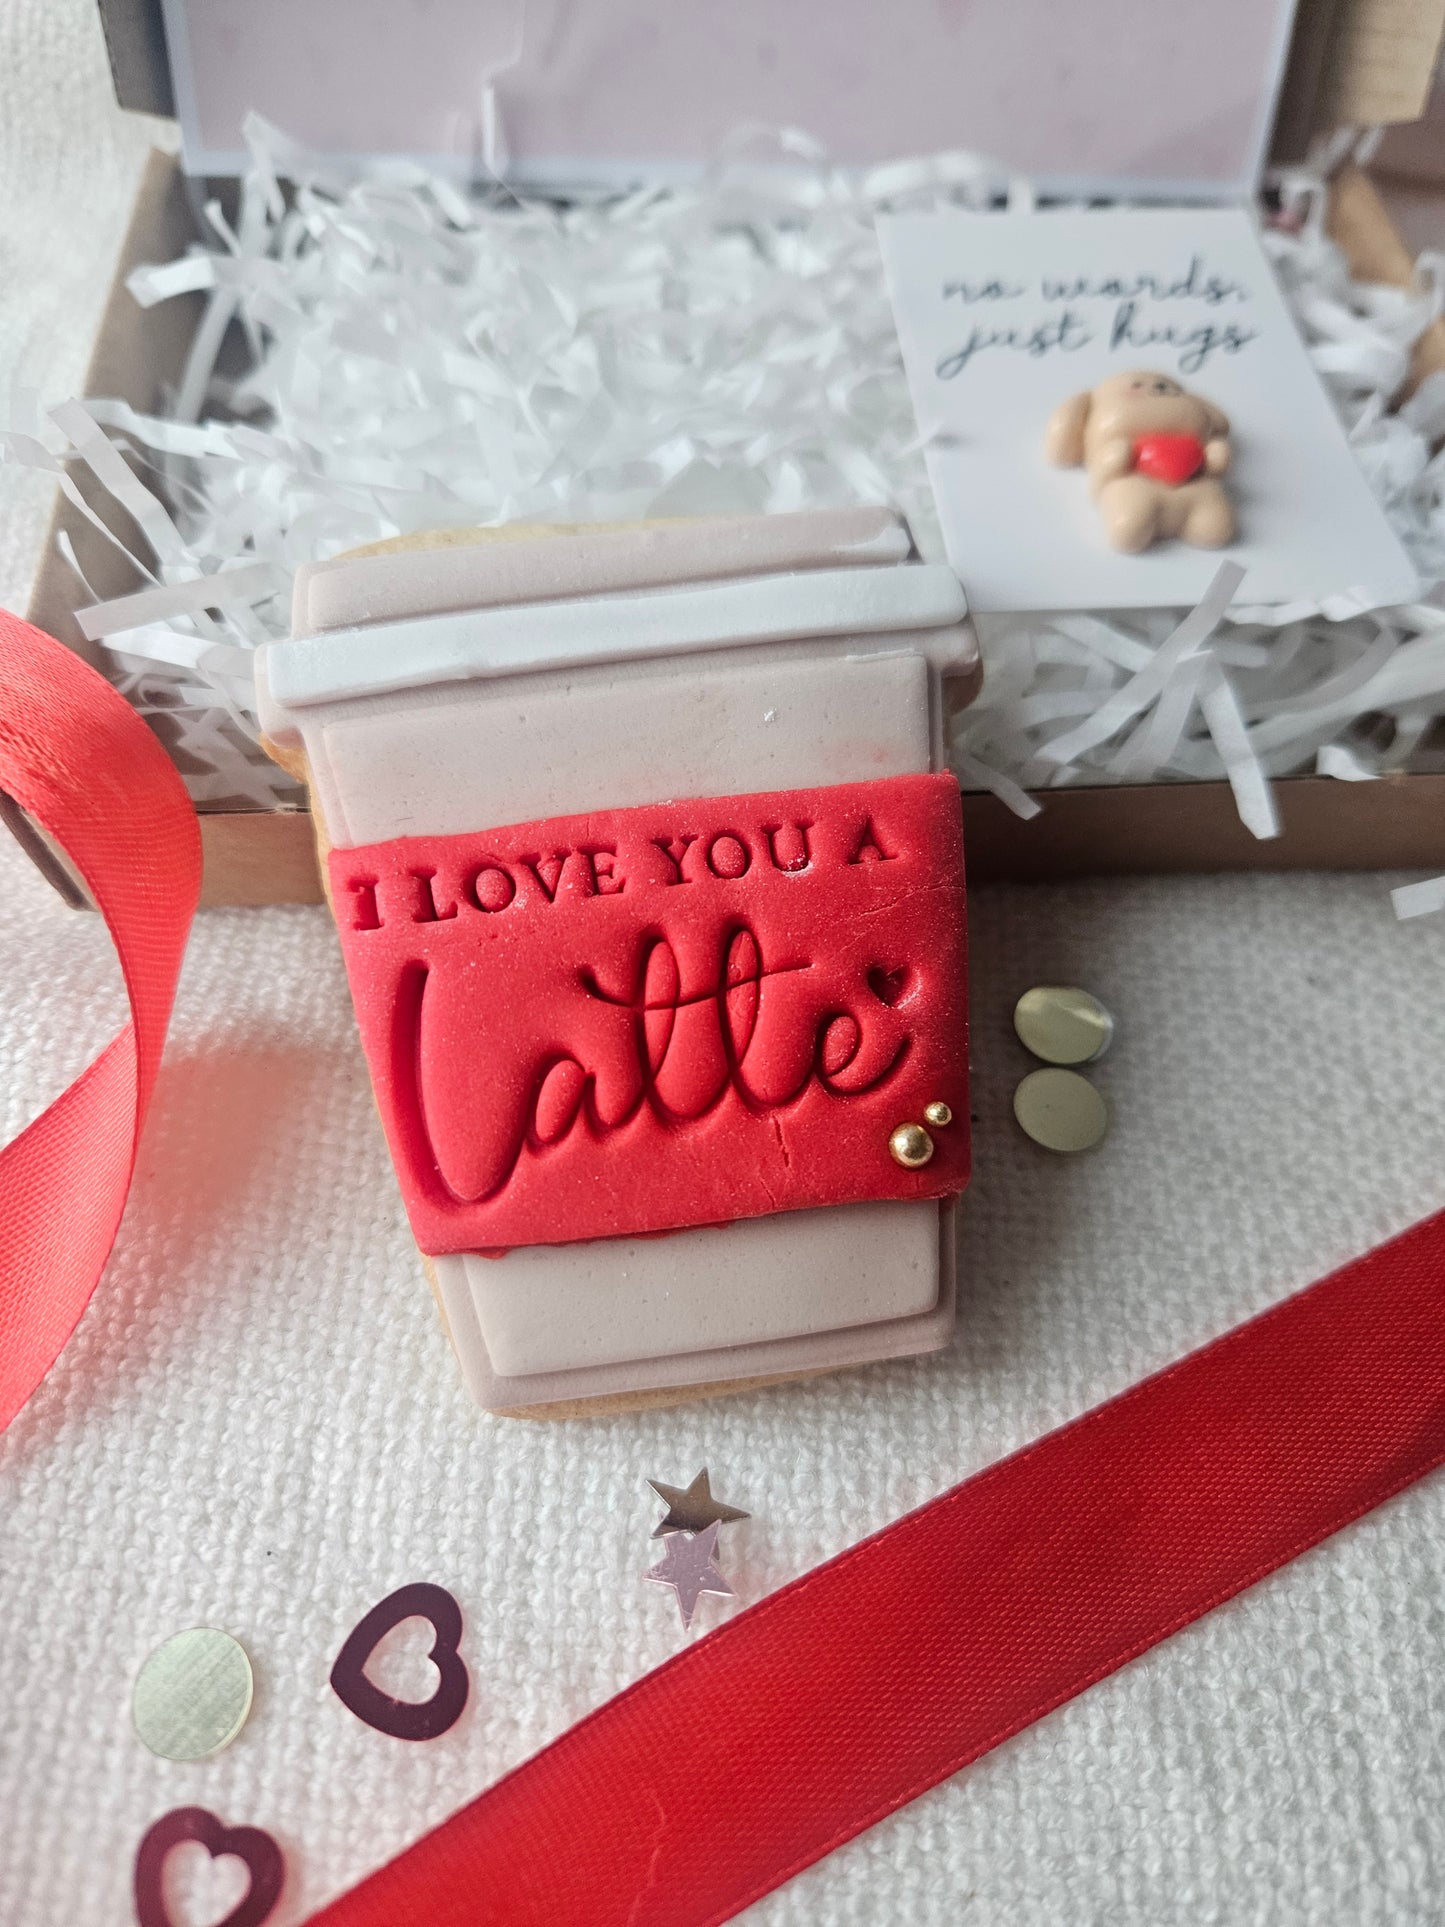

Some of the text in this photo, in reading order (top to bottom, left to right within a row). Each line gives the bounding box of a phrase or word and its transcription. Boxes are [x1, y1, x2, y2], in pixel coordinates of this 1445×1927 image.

[942, 269, 1025, 303] no
[934, 302, 1260, 381] just hugs
[346, 815, 900, 932] I LOVE YOU A
